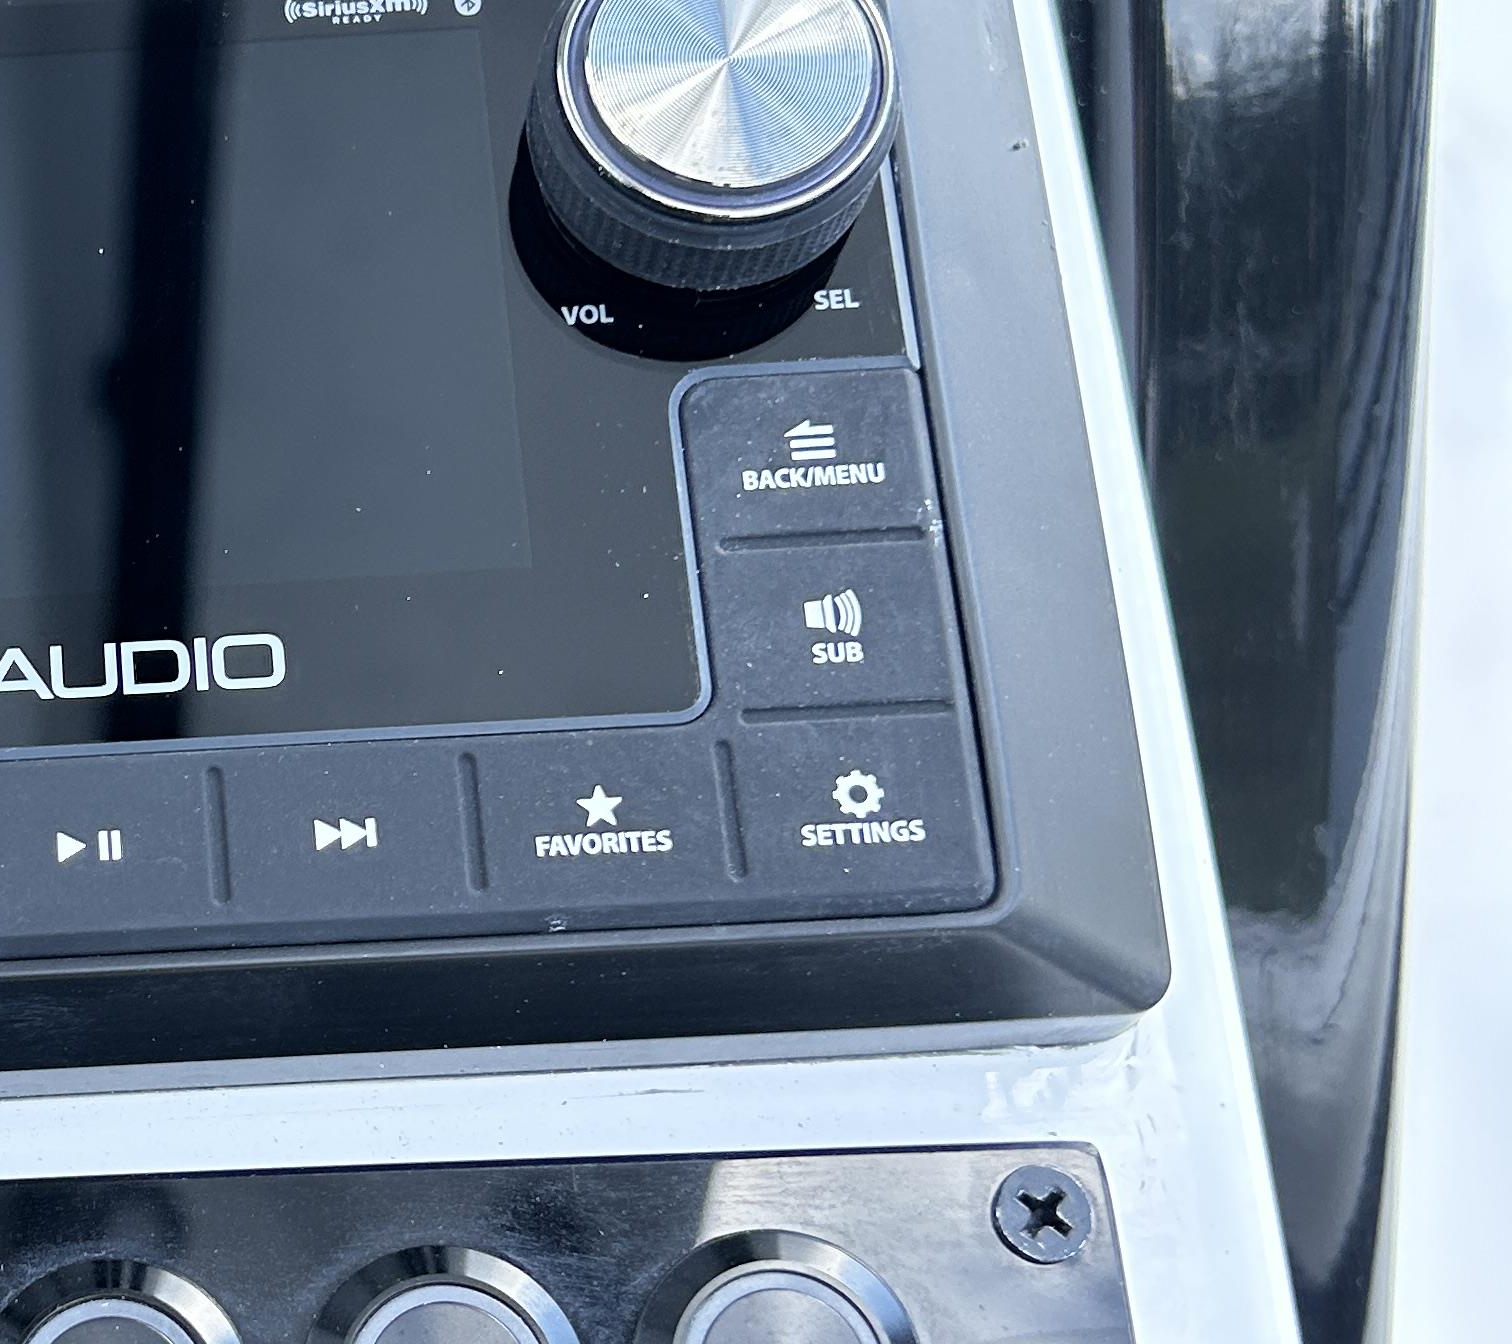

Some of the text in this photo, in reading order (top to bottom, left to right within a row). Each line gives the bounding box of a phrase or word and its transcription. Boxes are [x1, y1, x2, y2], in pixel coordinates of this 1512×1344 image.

[331, 13, 382, 25] READY
[813, 288, 861, 311] SEL
[560, 303, 615, 326] VOL
[742, 461, 886, 491] BACK/MENU
[811, 641, 865, 664] SUB
[535, 829, 674, 858] FAVORITES
[800, 818, 926, 847] SETTINGS
